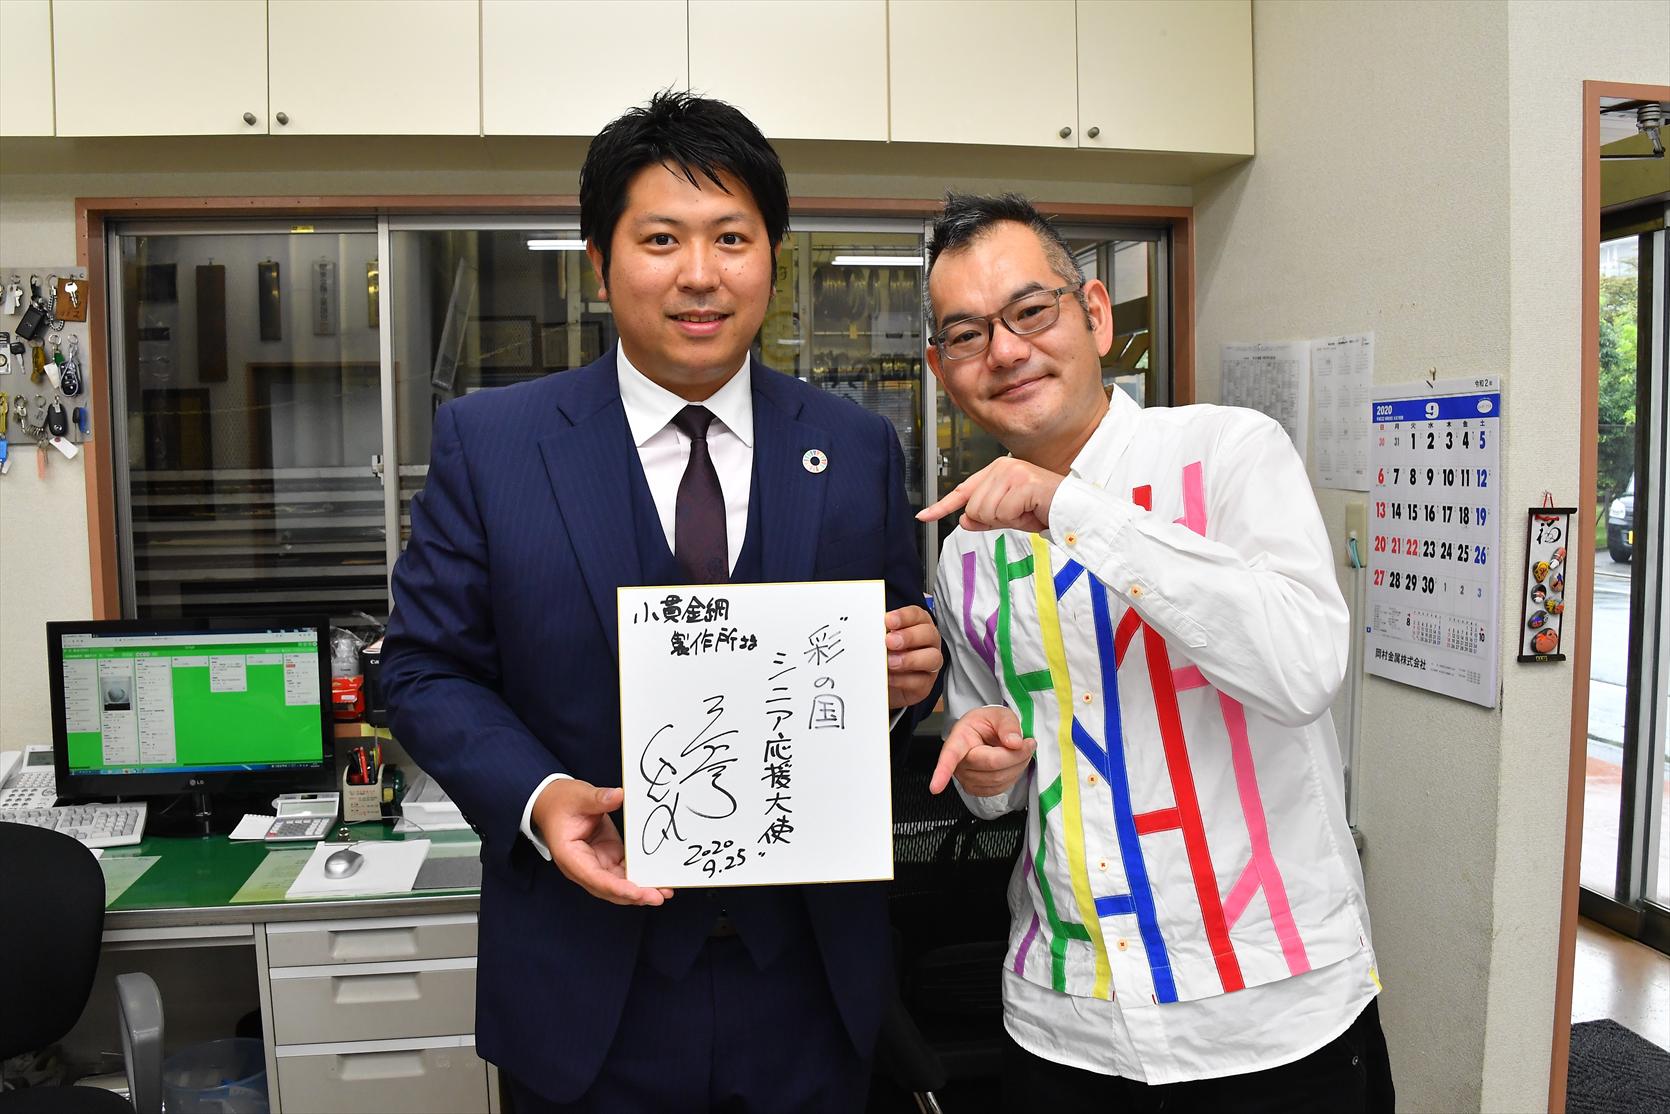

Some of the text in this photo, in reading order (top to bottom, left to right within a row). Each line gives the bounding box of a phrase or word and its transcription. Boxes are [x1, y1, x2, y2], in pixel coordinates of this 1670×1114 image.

[1377, 405, 1392, 415] 2020
[1425, 402, 1439, 419] 9
[1379, 431, 1485, 449] 30 31 1 2 3 4 5
[1378, 468, 1487, 487] 6 7 8 9 10 11 12
[1376, 502, 1486, 525] 13 14 15 16 17 18 19
[1375, 536, 1486, 564] 20 21 22 23 24 25 26
[1374, 569, 1482, 598] 27 28 29 30 1 2 3
[1375, 648, 1426, 670] 岡村金属株式会社
[683, 840, 734, 866] 2020
[702, 848, 746, 878] 9.25
